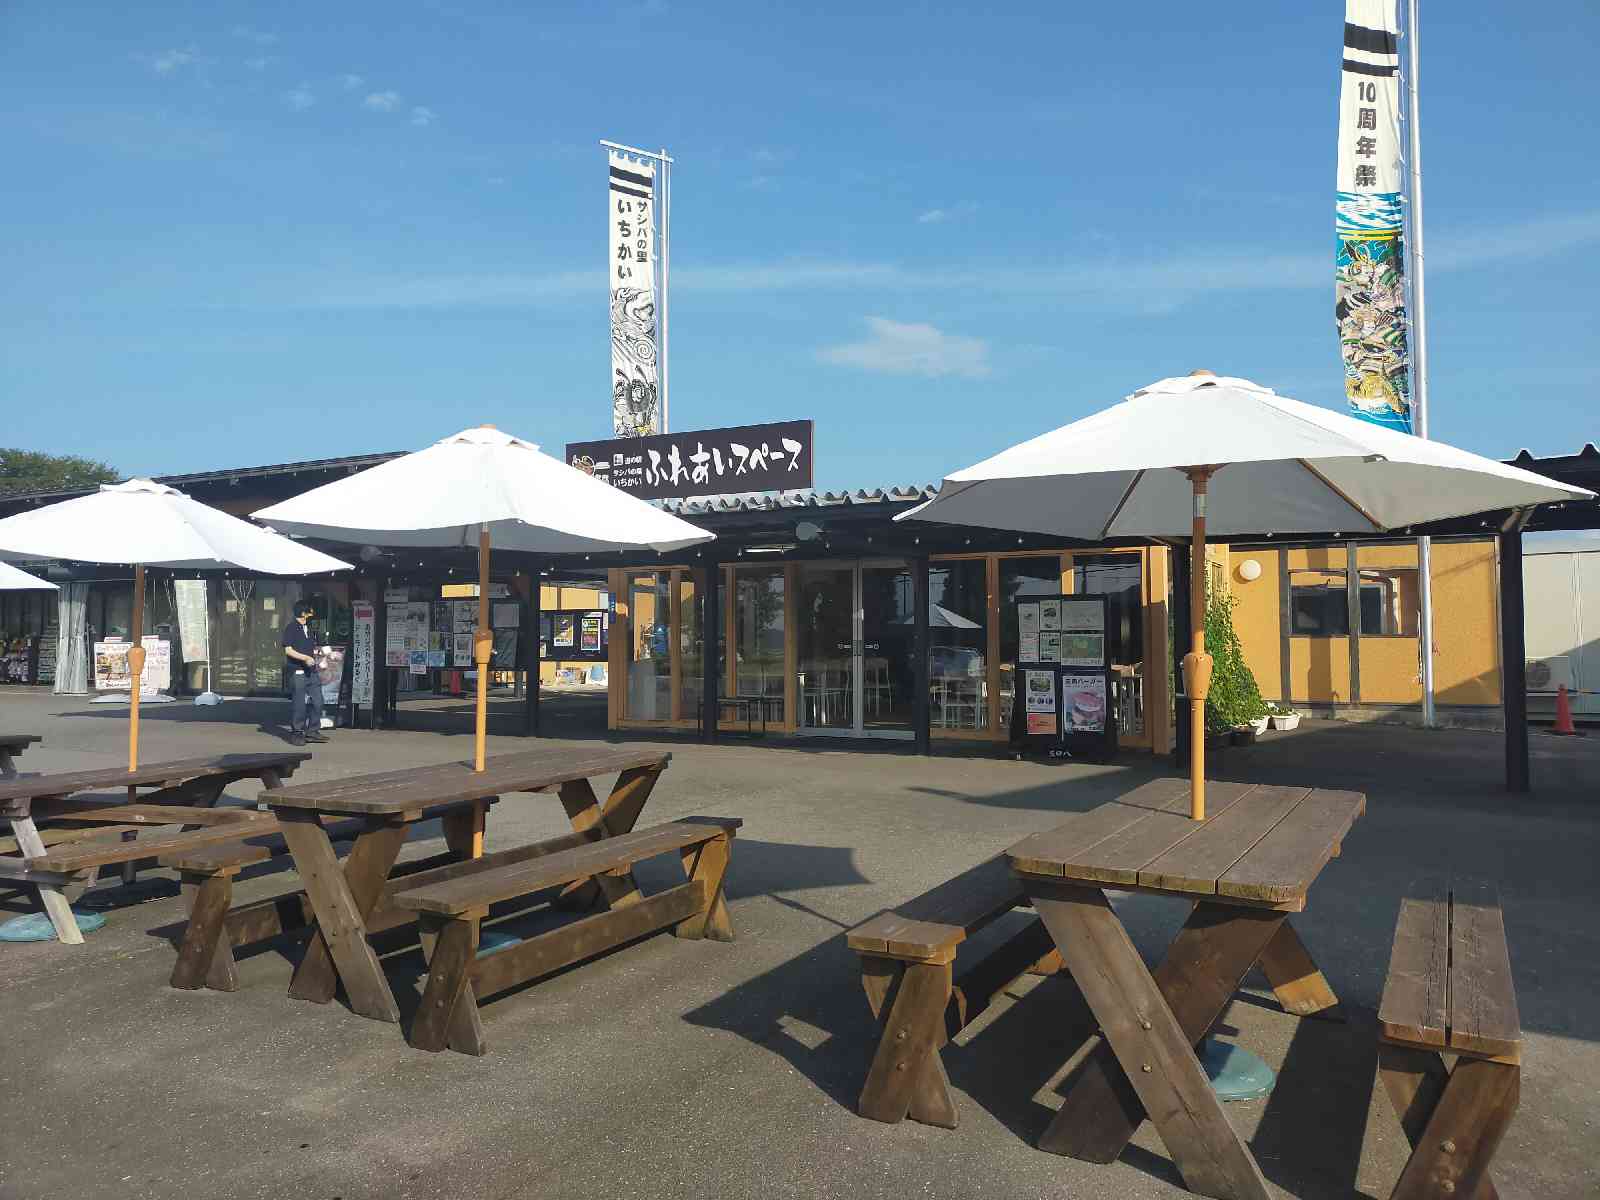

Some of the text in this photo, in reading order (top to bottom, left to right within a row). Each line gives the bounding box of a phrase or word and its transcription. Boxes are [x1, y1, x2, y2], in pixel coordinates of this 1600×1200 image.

[1356, 82, 1376, 187] 10周年祭
[617, 199, 633, 279] いちかい
[637, 201, 648, 263] サシバの里
[612, 477, 643, 488] いちかい
[646, 437, 803, 487] ふれあいスペース
